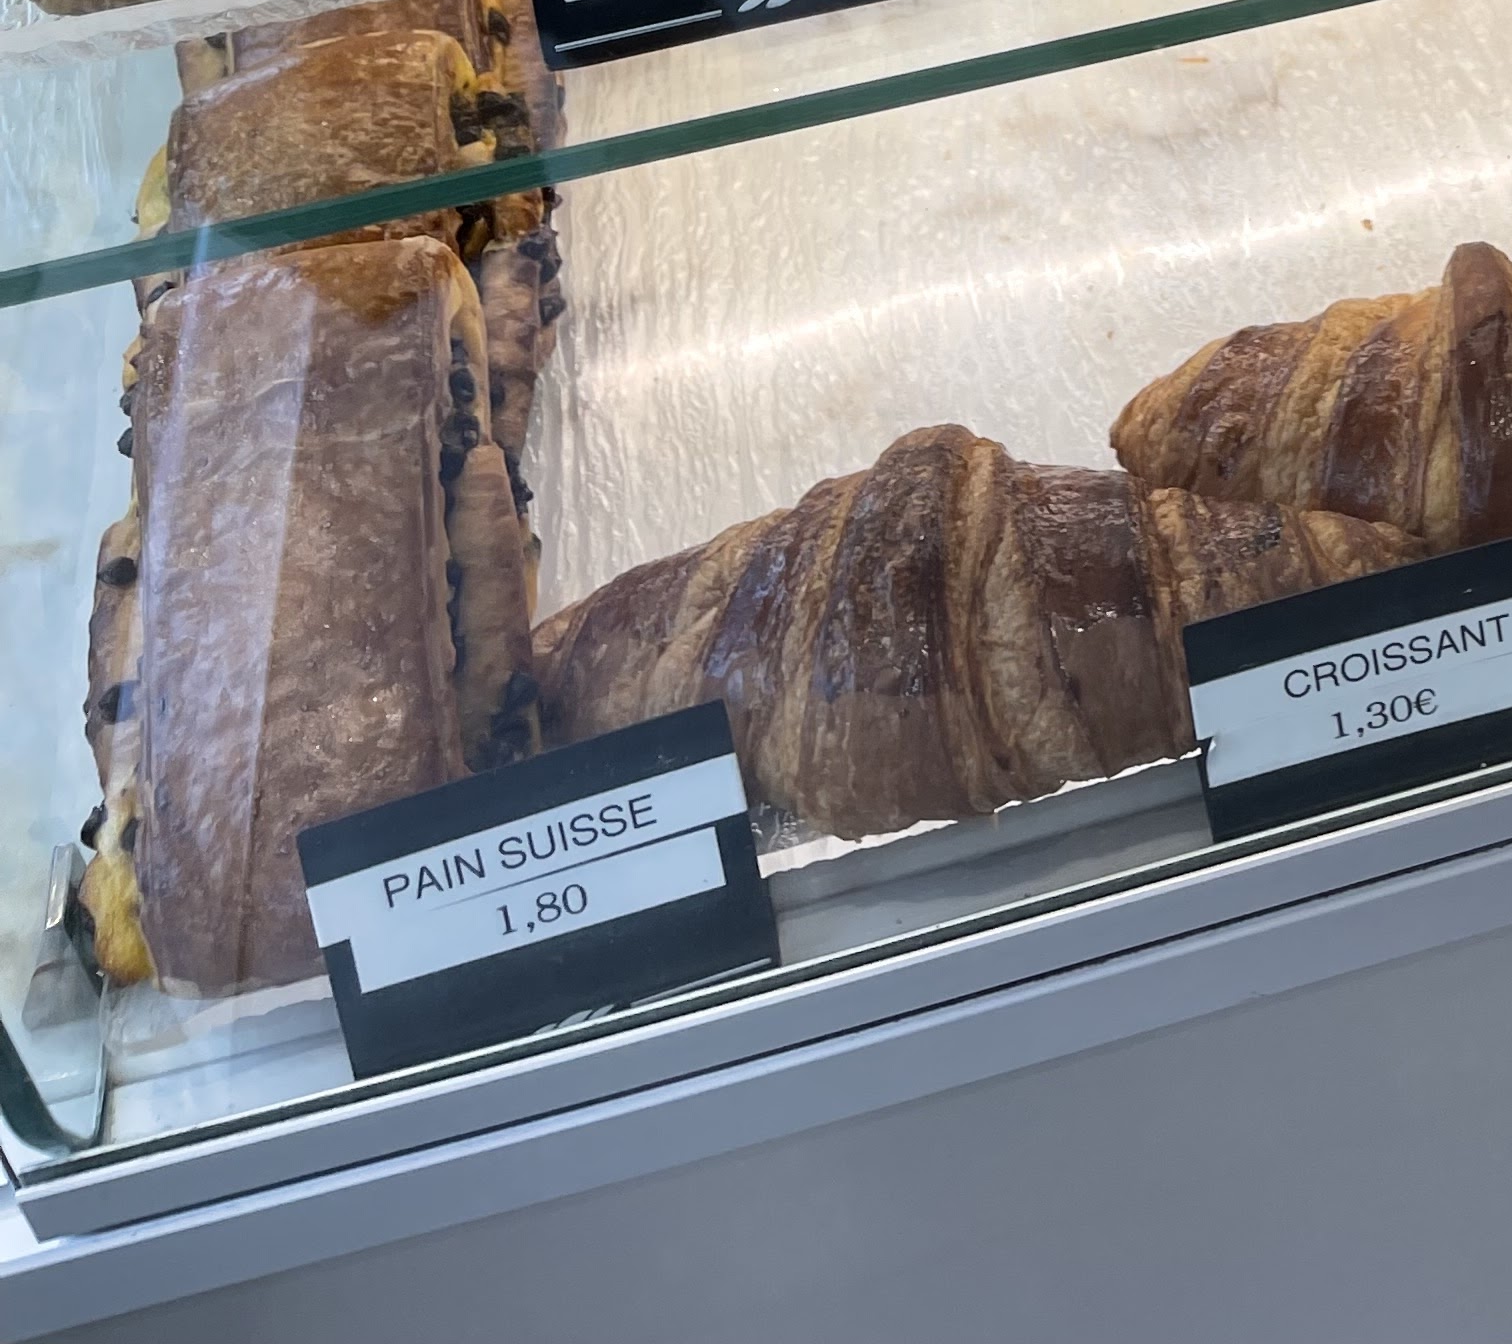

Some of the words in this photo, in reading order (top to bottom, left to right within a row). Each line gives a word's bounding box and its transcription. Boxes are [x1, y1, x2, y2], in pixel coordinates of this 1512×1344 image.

[1283, 613, 1510, 699] CROISSANT
[1332, 687, 1439, 740] 1,30€
[382, 848, 486, 908] PAIN
[497, 794, 658, 870] SUISSE
[496, 883, 589, 936] 1,80
